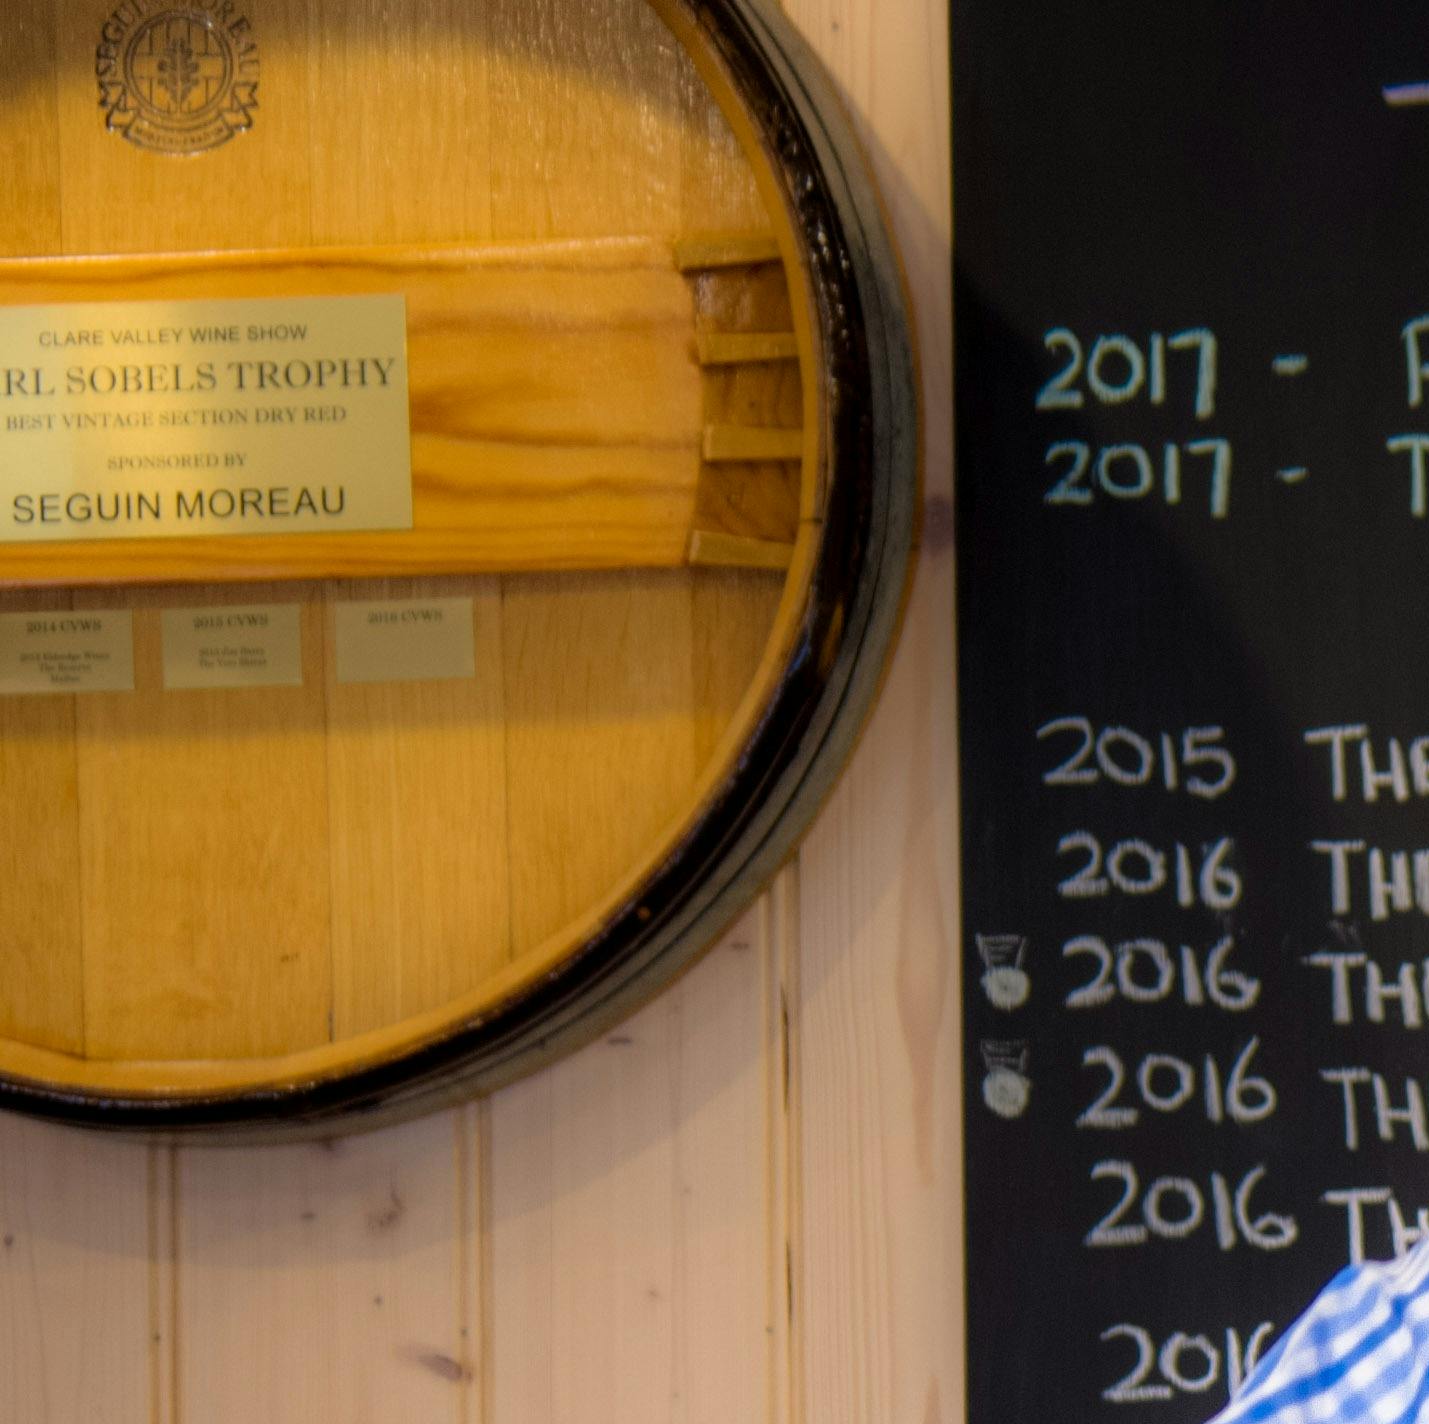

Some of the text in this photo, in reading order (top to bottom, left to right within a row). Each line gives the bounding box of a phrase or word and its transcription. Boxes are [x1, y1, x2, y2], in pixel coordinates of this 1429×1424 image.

[39, 324, 307, 347] CLARE VALLEY WINE SHOW
[1036, 328, 1217, 418] 2017
[0, 357, 395, 396] RL SOBELS TROPHY
[6, 404, 347, 432] BEST VINTAGE SECTION DRY RED
[107, 452, 247, 471] SPONSORED BY
[1045, 440, 1230, 519] 2017
[13, 485, 346, 524] SEGUIN MOREAU
[1036, 716, 1236, 798] 2015
[1057, 831, 1242, 909] 2016
[1062, 935, 1260, 1011] 2016
[1077, 1036, 1277, 1128] 2016
[1085, 1160, 1297, 1251] 2016
